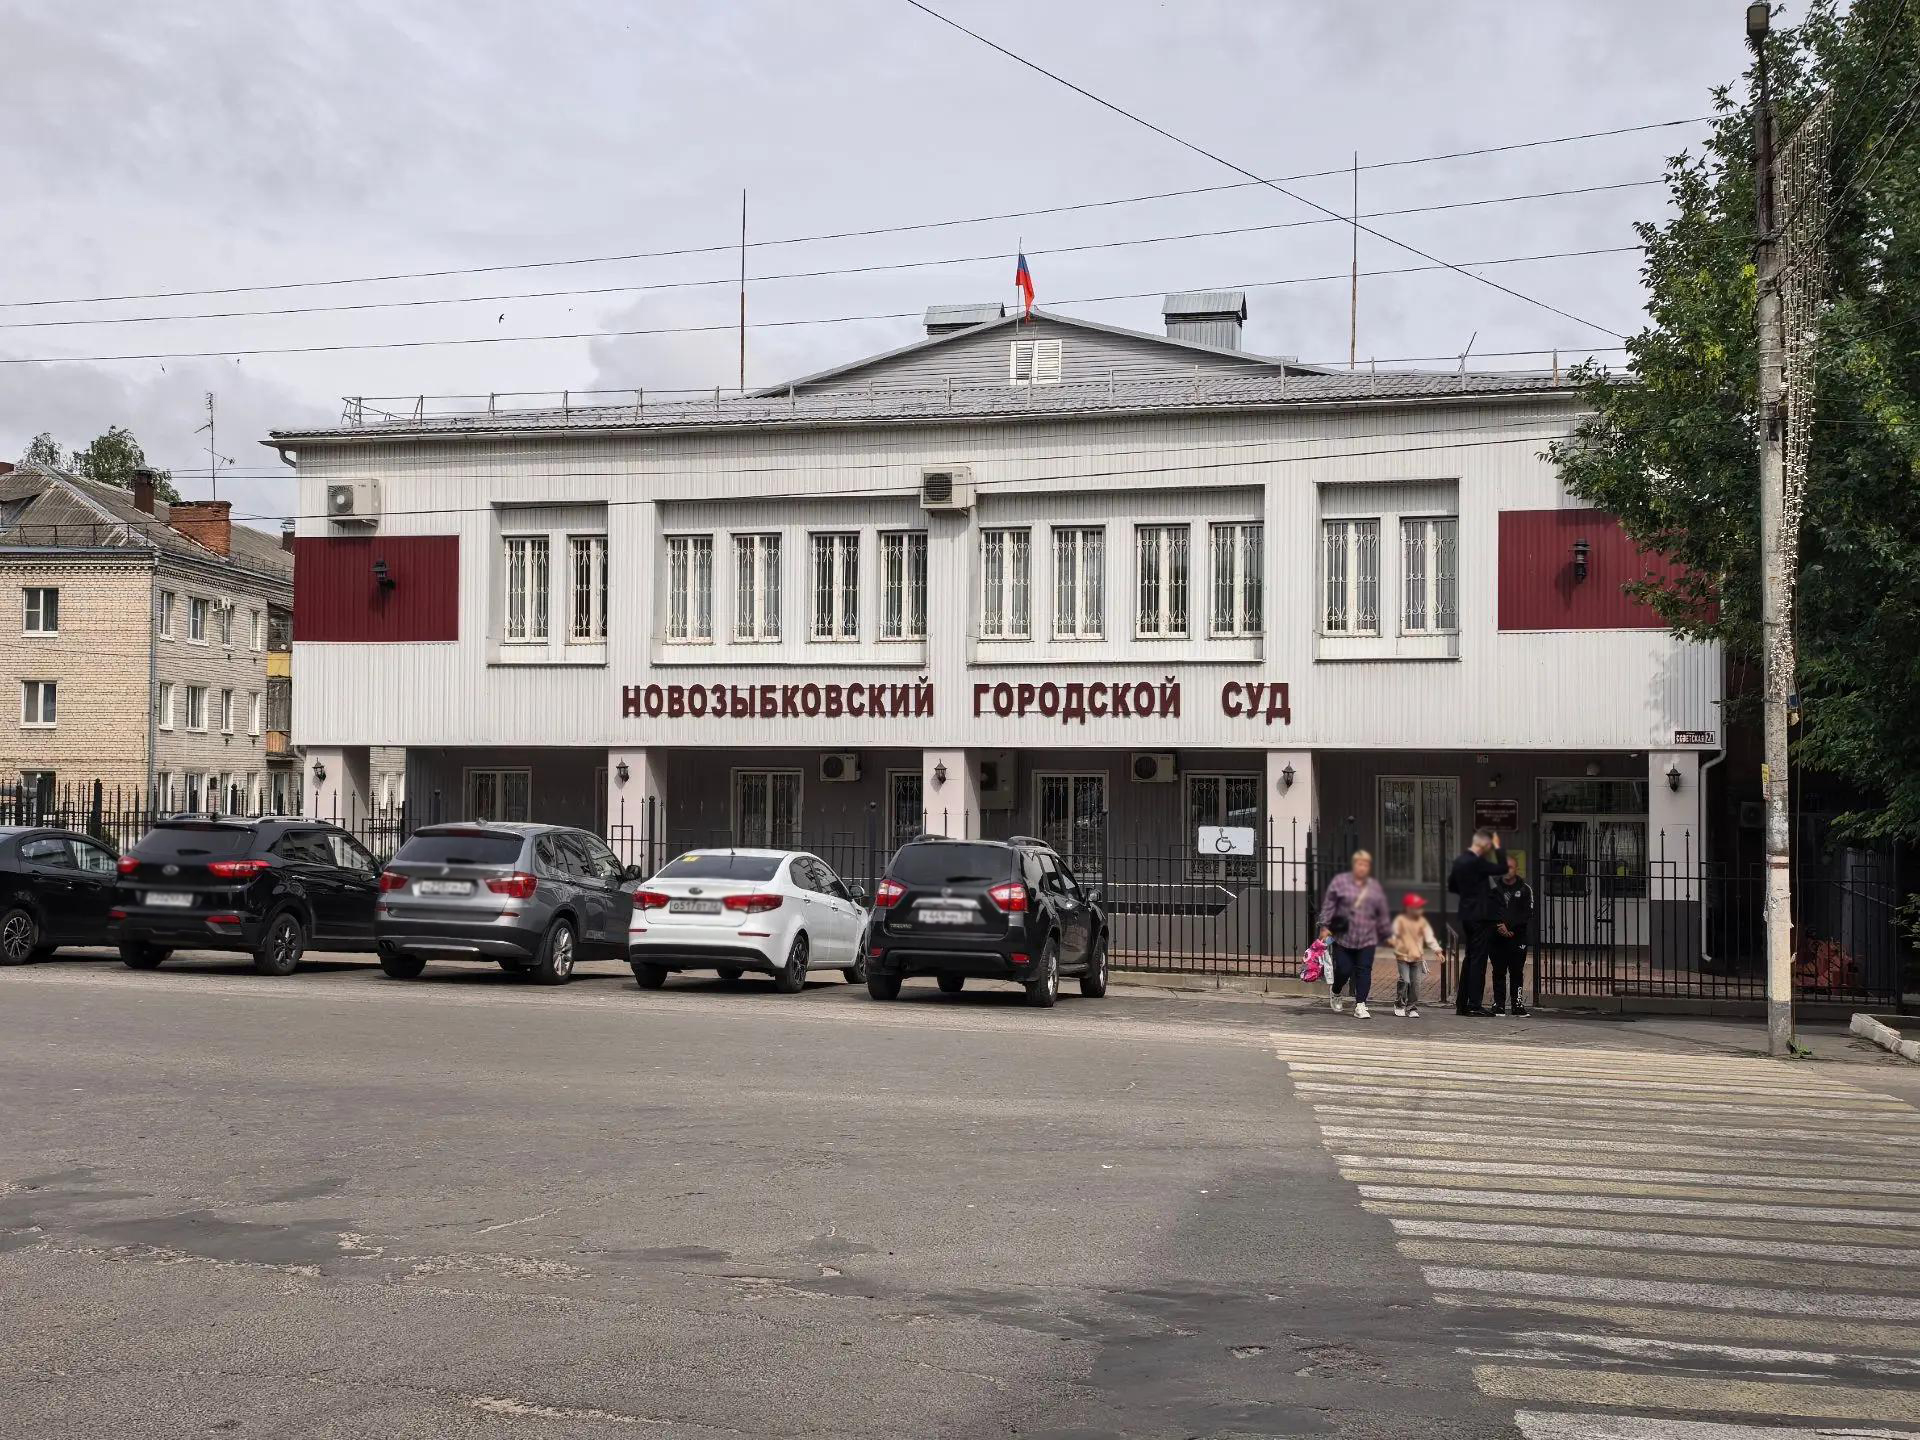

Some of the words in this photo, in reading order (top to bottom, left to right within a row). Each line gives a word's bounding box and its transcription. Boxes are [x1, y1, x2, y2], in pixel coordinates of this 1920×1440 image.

[622, 675, 934, 719] НОВОЗЫБКОВСКИЙ
[973, 675, 1181, 725] ГОРОДСКОЙ
[1222, 681, 1291, 726] СУД
